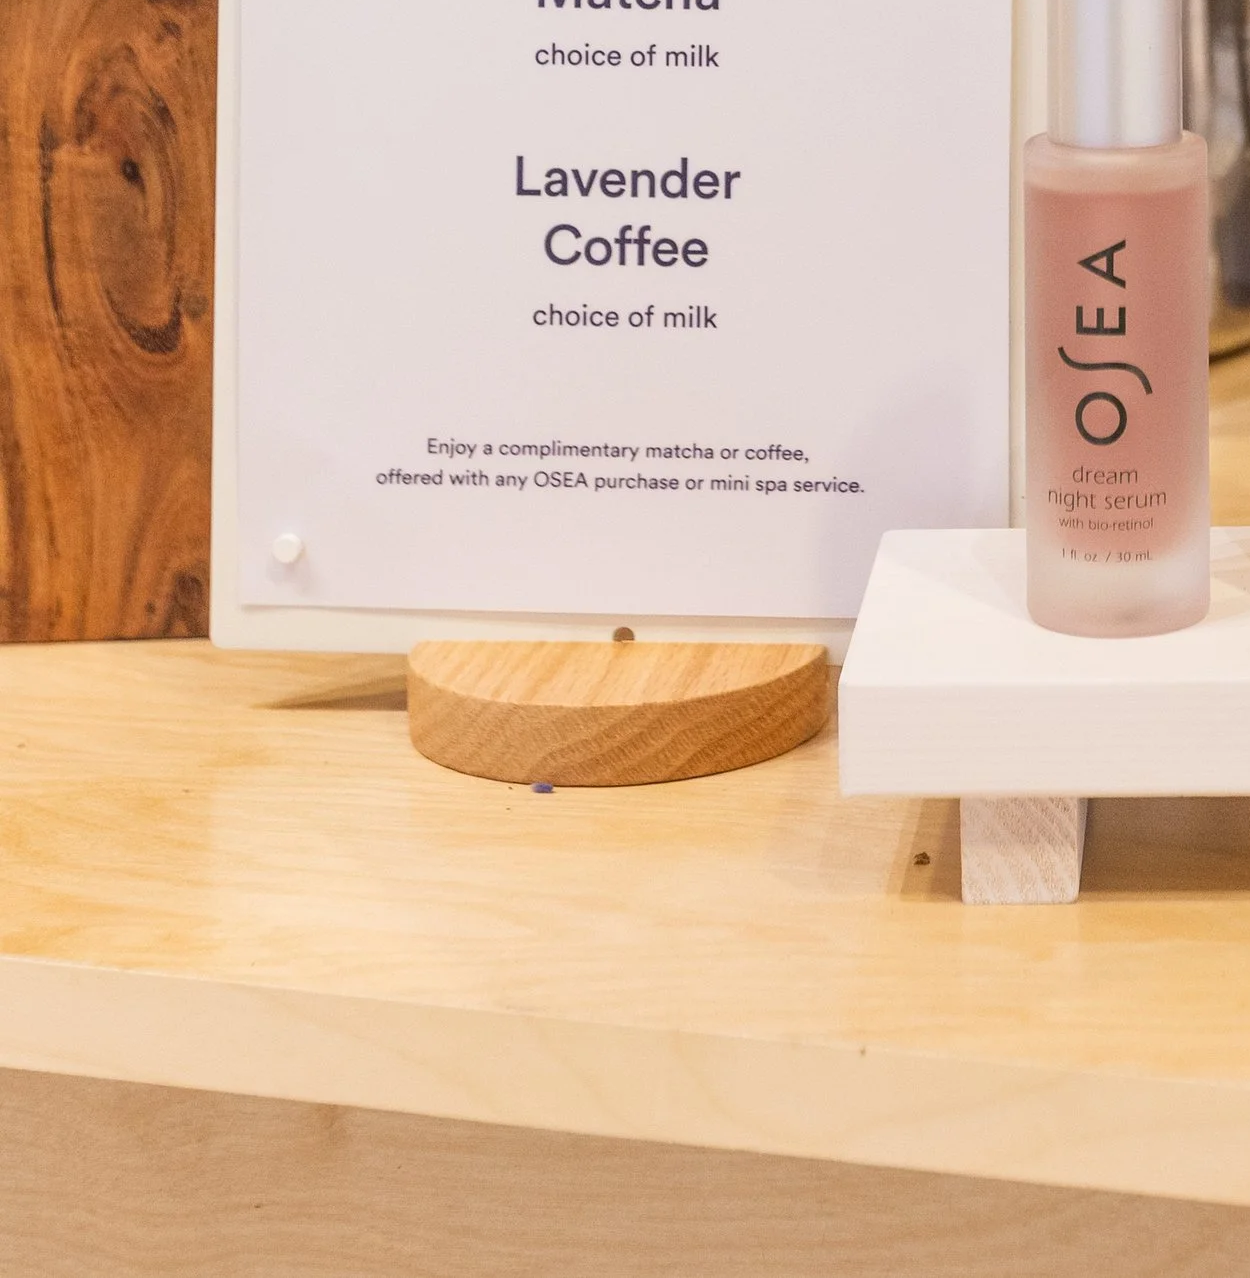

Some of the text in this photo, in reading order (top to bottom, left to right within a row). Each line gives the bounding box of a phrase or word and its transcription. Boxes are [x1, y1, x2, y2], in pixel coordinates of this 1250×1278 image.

[534, 42, 719, 68] choice of milk
[515, 155, 742, 200] Lavender
[543, 223, 709, 268] Coffee
[532, 303, 718, 329] choice of milk
[1057, 239, 1154, 446] OSEA
[427, 437, 810, 464] Enjoy a complimentary matcha or coffee,
[375, 468, 865, 496] offered with any OSEA purchase or mini spa service.
[1071, 464, 1139, 485] dream
[1047, 486, 1167, 513] night serum
[1058, 515, 1154, 532] with bio-retinol
[1061, 547, 1066, 558] 1
[1105, 550, 1113, 563] /
[1117, 551, 1132, 563] 30
